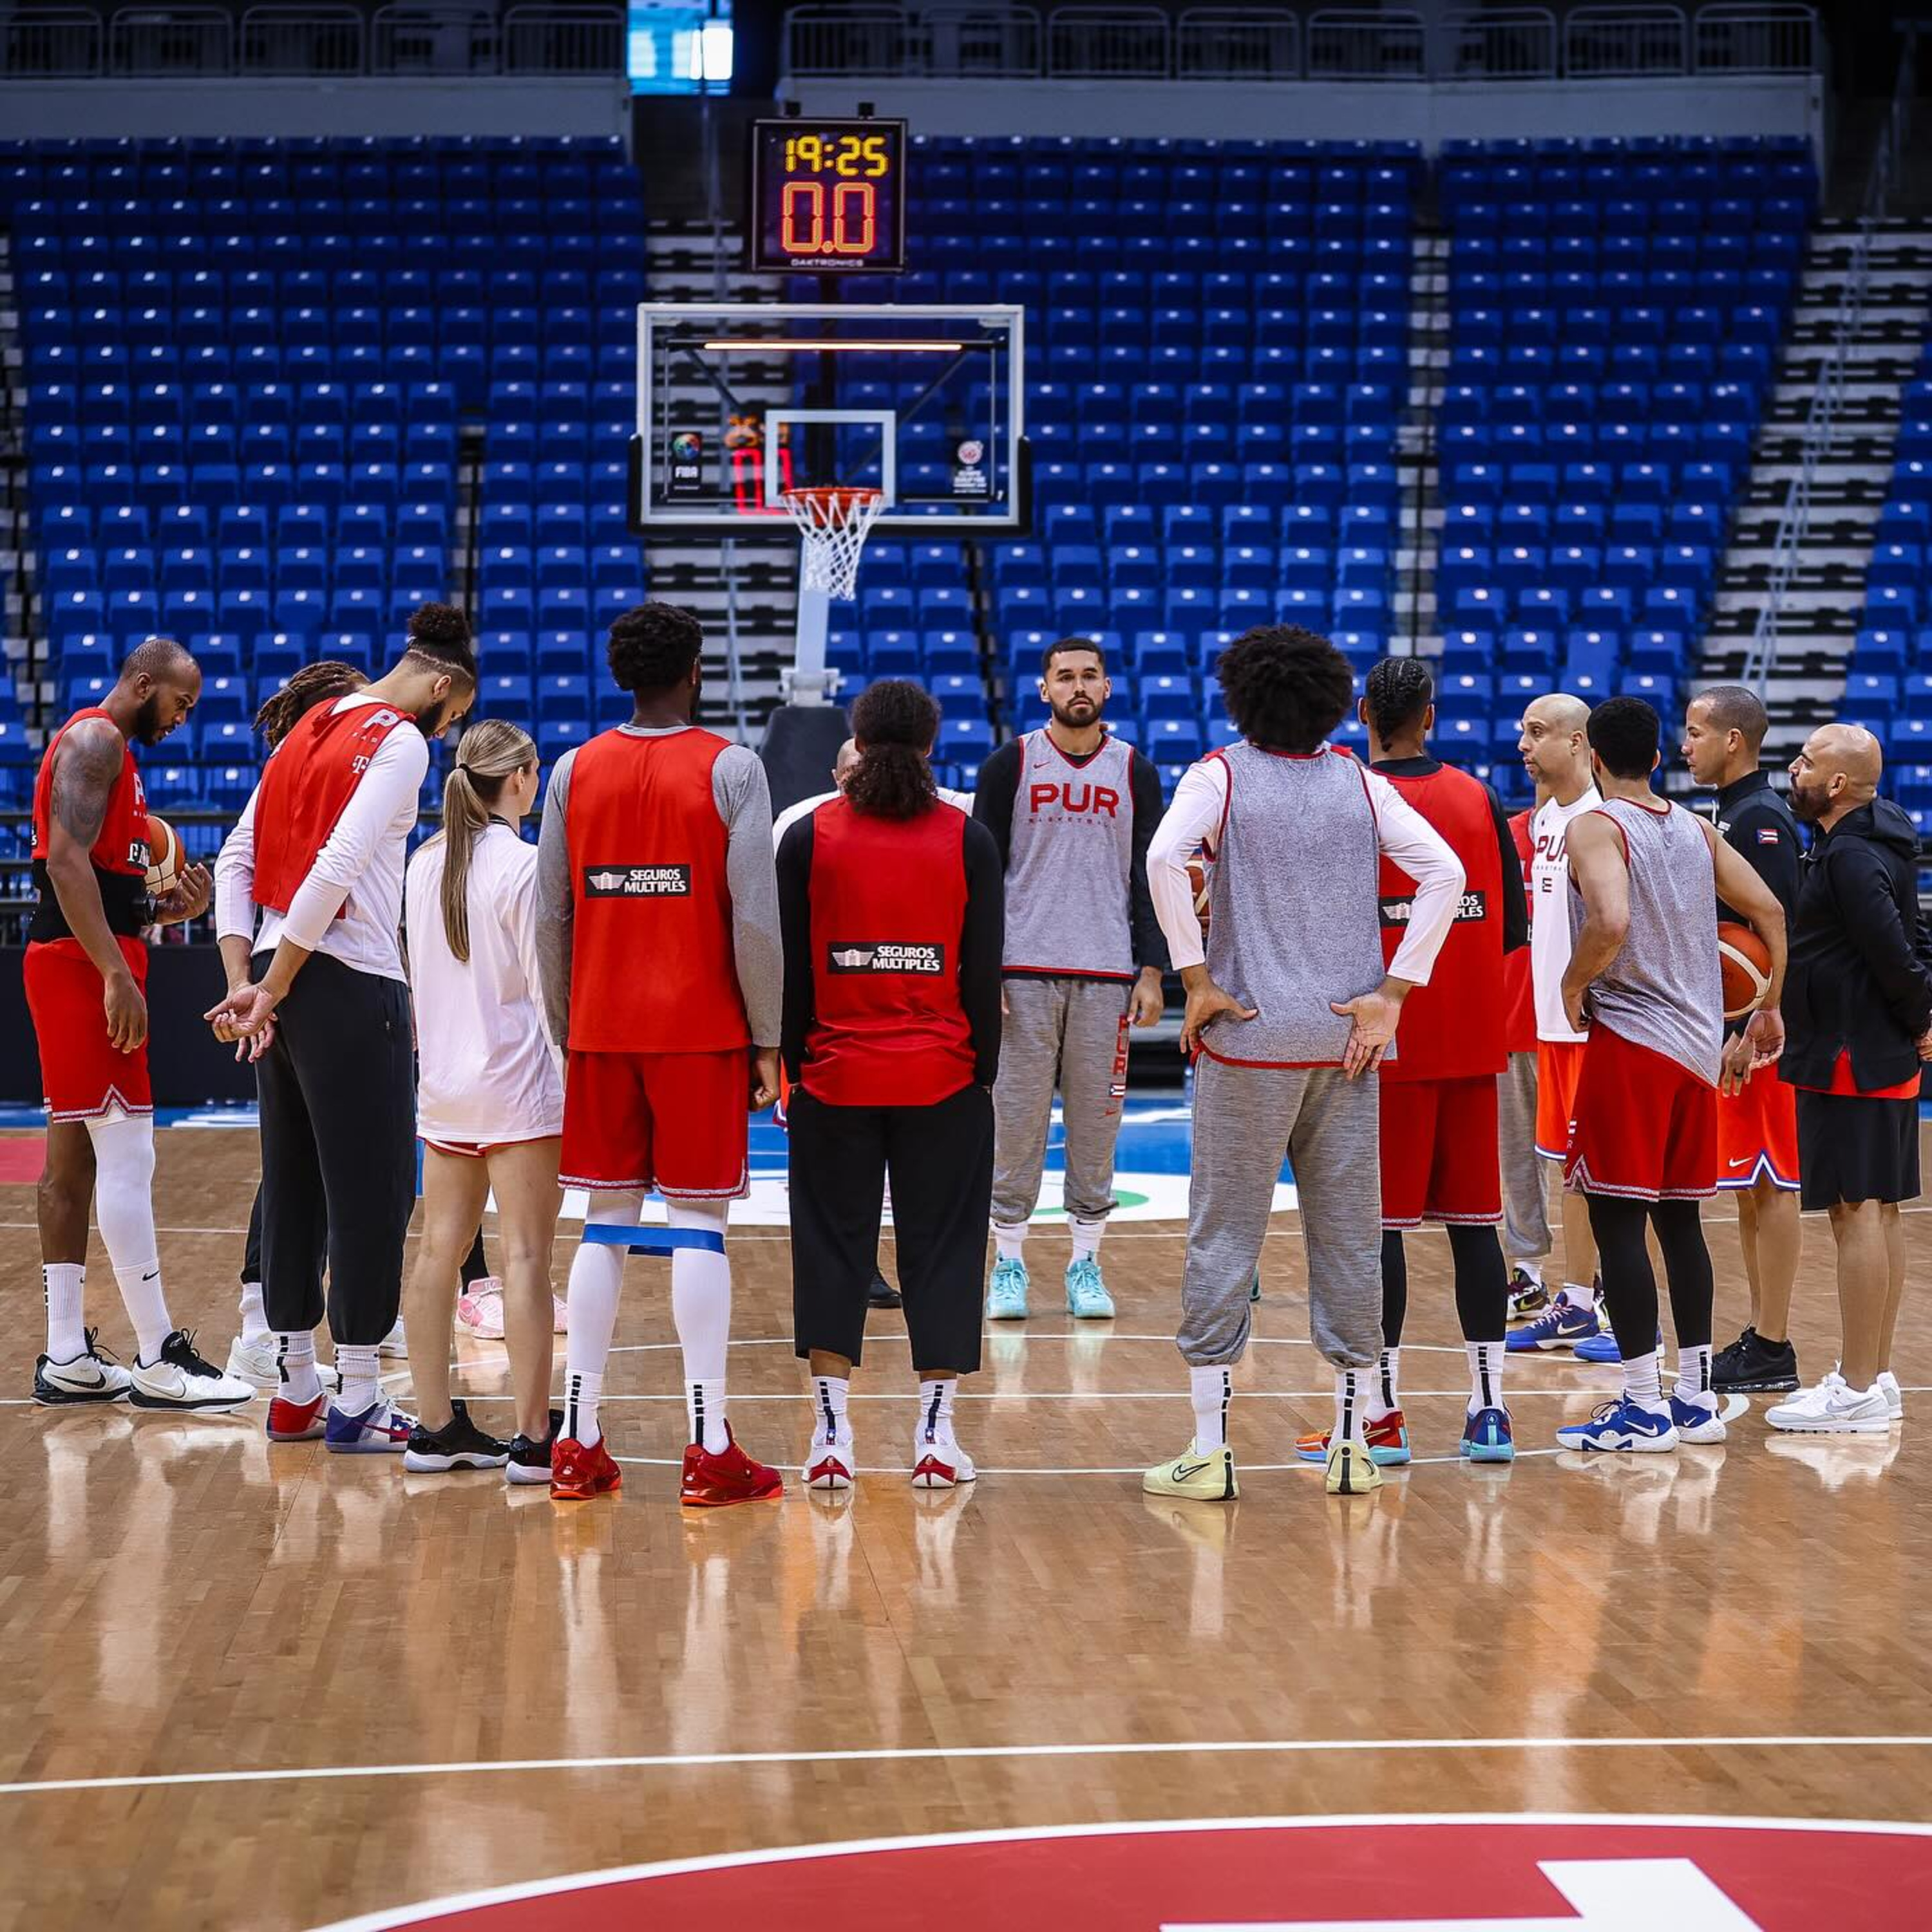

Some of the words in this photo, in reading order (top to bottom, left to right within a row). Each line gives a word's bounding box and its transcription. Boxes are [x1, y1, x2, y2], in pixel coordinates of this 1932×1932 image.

[786, 136, 889, 176] 19:25
[782, 182, 875, 253] 0.0
[1030, 783, 1119, 819] PUR
[630, 869, 681, 881] SEGUROS
[624, 880, 687, 893] MULTIPLES
[877, 945, 935, 959] SEGUROS
[872, 958, 940, 971] MULTIPLES
